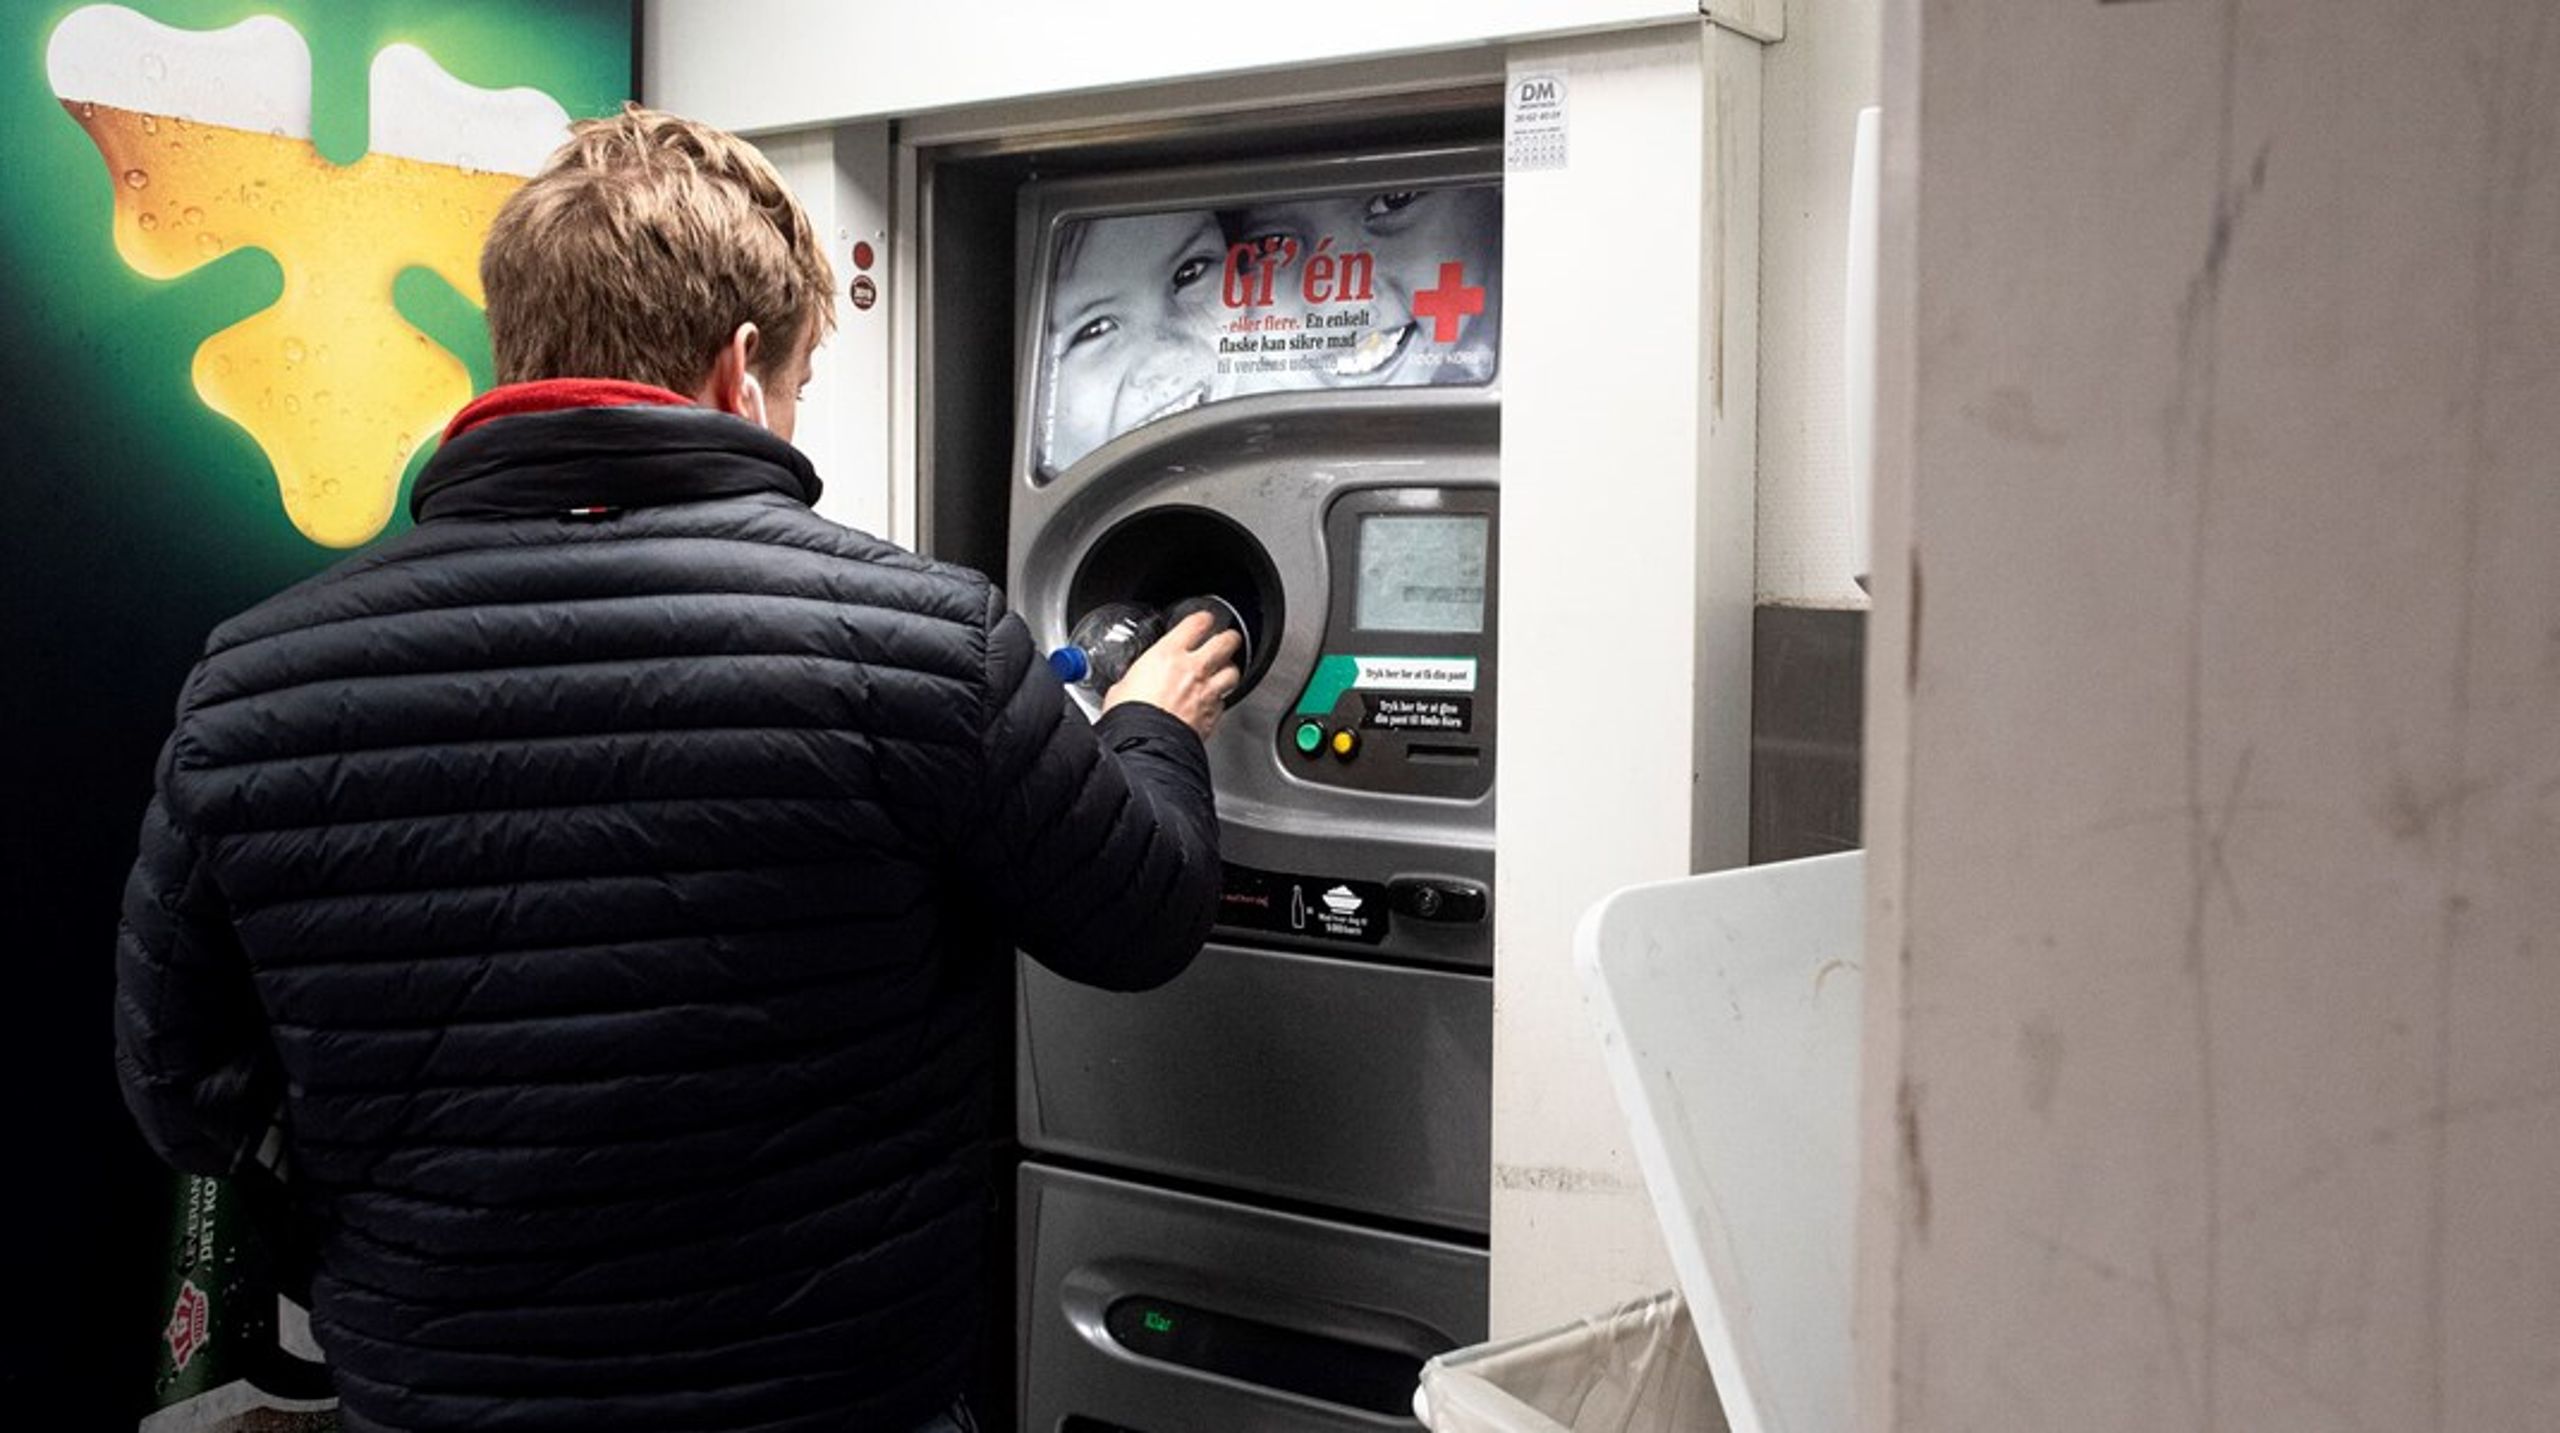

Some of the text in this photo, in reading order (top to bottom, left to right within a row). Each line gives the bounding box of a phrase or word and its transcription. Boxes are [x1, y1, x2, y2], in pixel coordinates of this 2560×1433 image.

[1521, 82, 1555, 101] DM
[1229, 316, 1261, 333] eller
[1265, 315, 1300, 332] flere.
[1306, 313, 1323, 329] En
[1326, 310, 1370, 328] enkelt
[1219, 331, 1357, 353] flaske kan sikre mad
[1217, 359, 1231, 374] til
[1234, 355, 1286, 373] verdens
[1366, 668, 1383, 680] Tryk
[1385, 668, 1399, 678] her
[1401, 669, 1412, 679] for
[1414, 670, 1422, 679] at
[1433, 669, 1446, 680] din
[1447, 670, 1467, 682] pant
[1380, 700, 1398, 714] Tryk
[1400, 701, 1414, 712] her
[1416, 701, 1428, 713] for
[1375, 712, 1388, 724] din
[1389, 714, 1407, 727] pant
[184, 1174, 201, 1268] LEVERAN
[200, 1176, 218, 1261] DET KO
